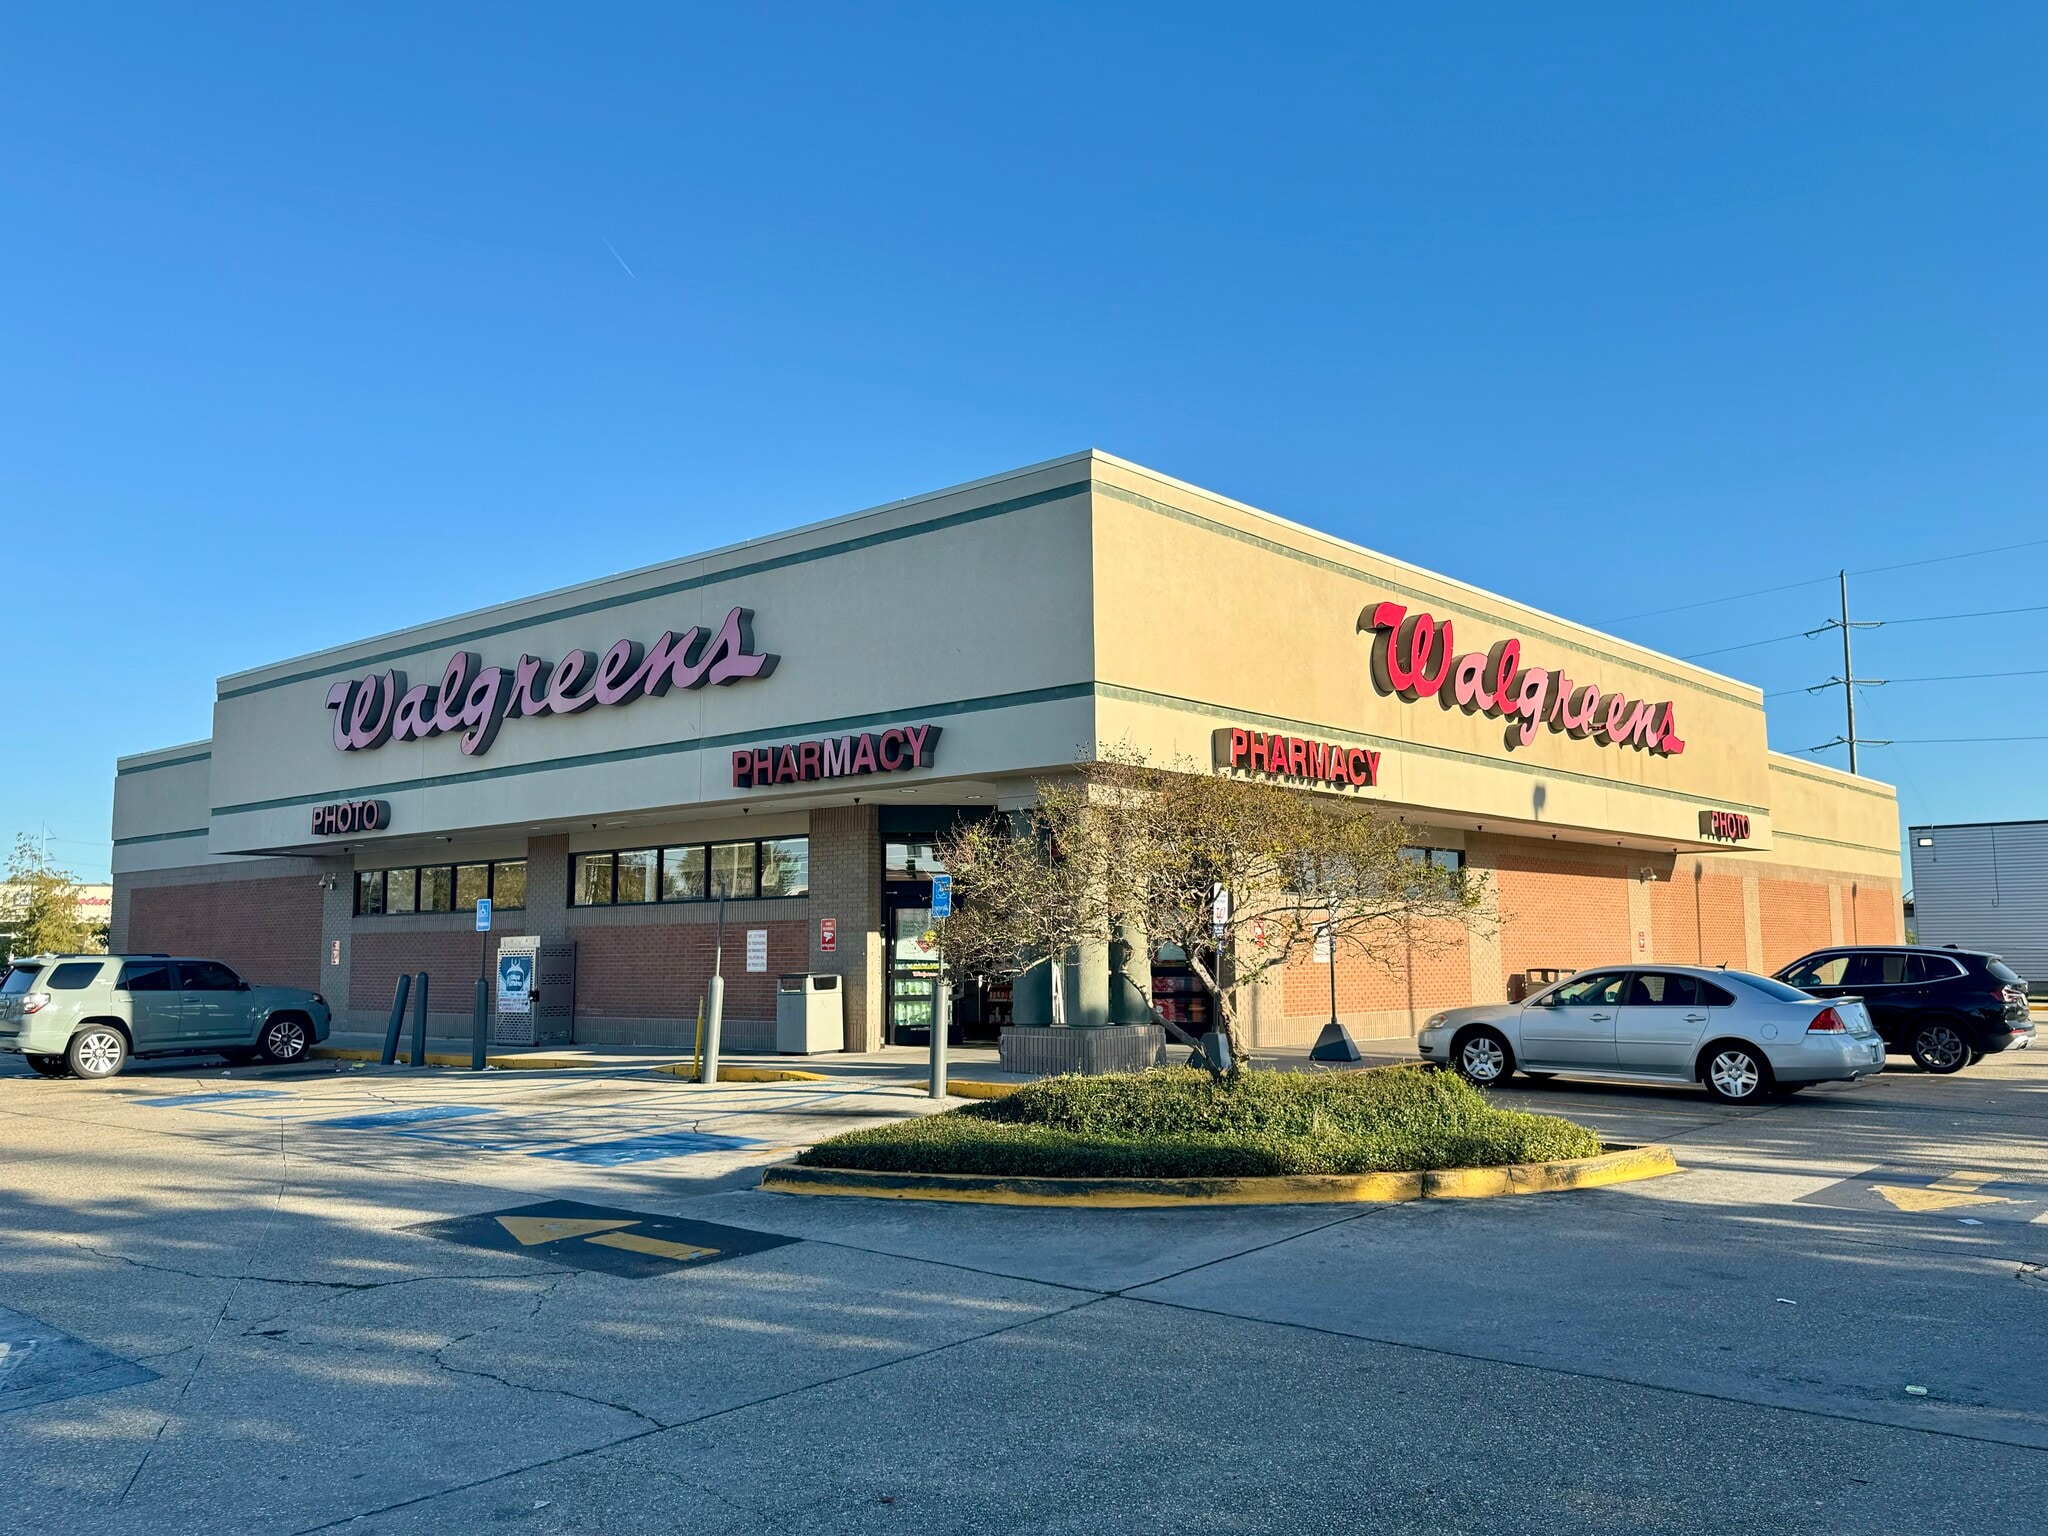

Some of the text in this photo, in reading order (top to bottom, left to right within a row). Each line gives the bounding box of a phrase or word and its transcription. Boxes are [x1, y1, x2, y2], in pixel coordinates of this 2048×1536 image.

[325, 606, 772, 756] Walgreens
[1366, 602, 1686, 755] Walgreens
[732, 724, 935, 788] PHARMACY
[1230, 727, 1382, 787] PHARMACY
[312, 800, 379, 835] PHOTO
[1711, 811, 1751, 840] PHOTO
